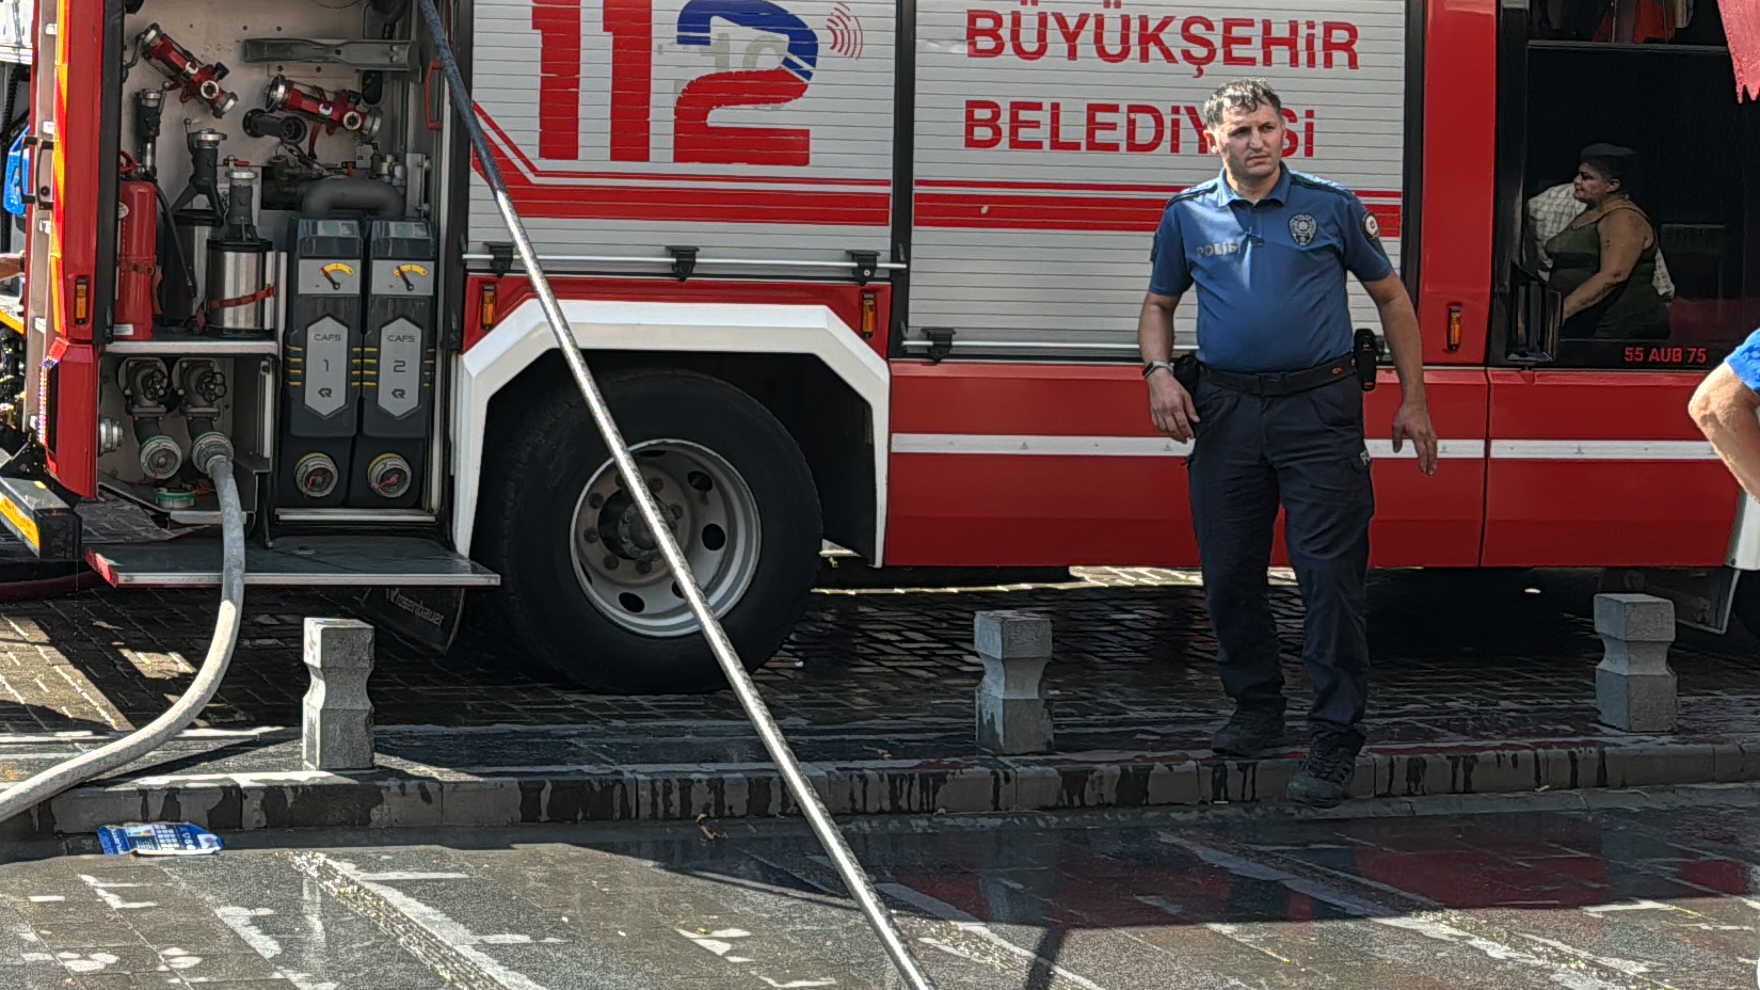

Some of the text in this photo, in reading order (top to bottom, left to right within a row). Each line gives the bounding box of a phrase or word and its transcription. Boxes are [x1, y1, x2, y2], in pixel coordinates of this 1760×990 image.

[313, 333, 342, 342] CAFS
[387, 334, 415, 343] CAFS
[1623, 346, 1644, 362] 55
[1686, 347, 1708, 364] 75
[393, 359, 406, 373] 2
